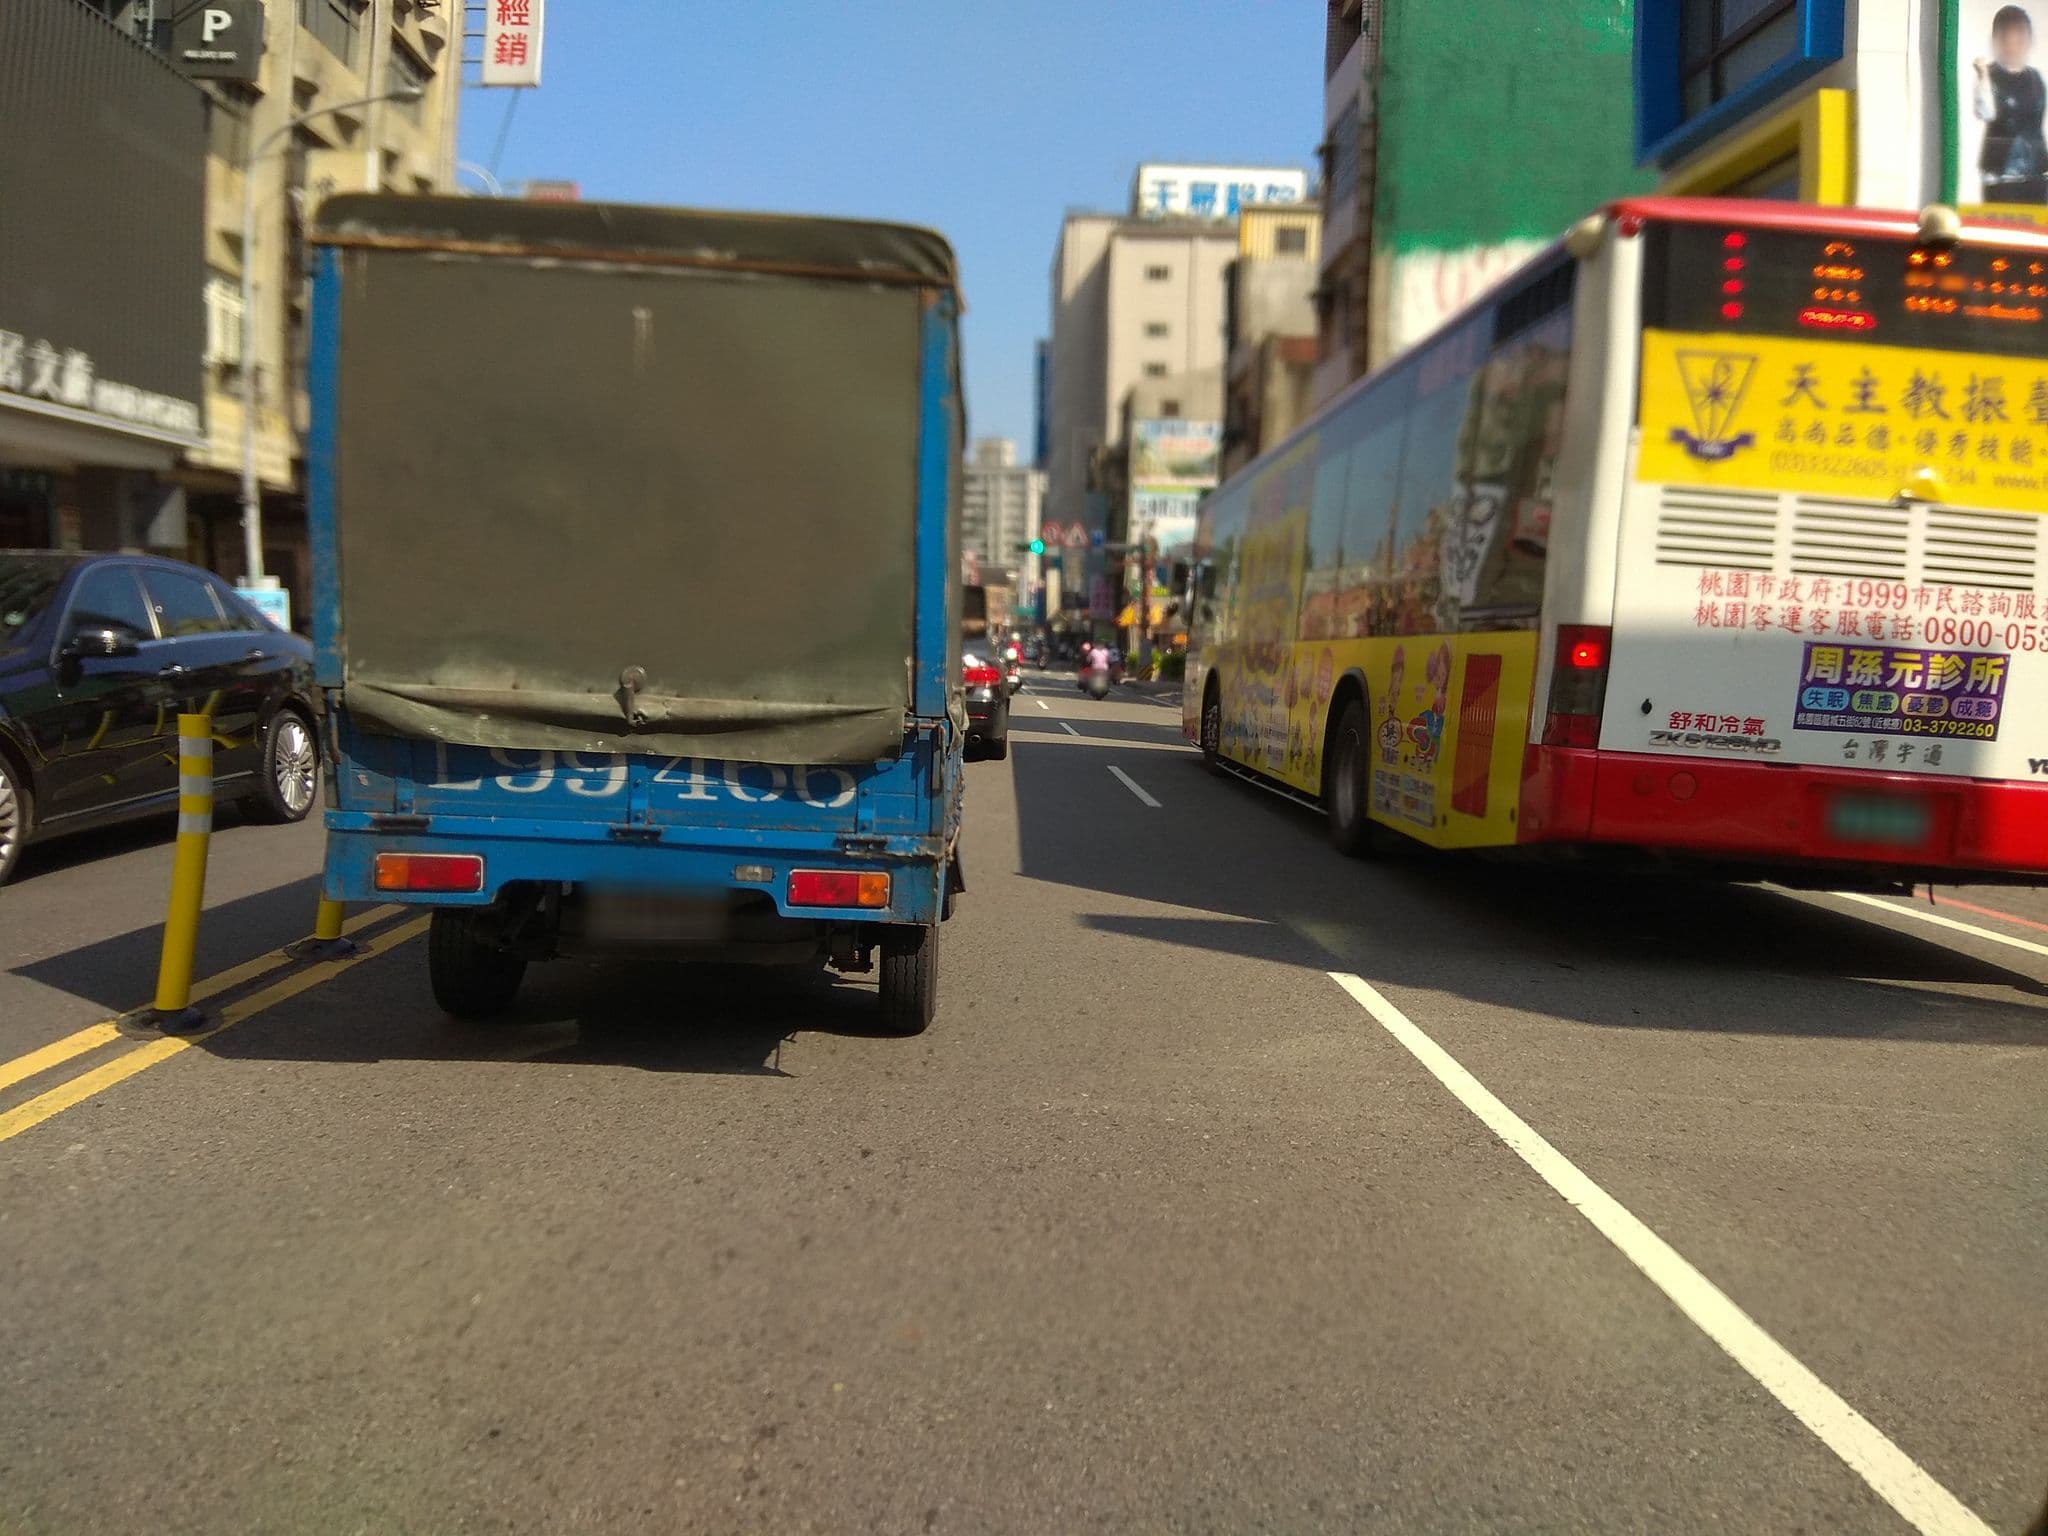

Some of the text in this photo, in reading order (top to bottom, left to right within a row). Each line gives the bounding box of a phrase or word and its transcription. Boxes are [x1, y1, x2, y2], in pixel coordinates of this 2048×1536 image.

[202, 9, 232, 42] P
[1805, 645, 2005, 695] 周孫元診所
[1807, 688, 1845, 709] 失眠
[1857, 691, 1894, 712] 焦慮
[1906, 695, 1944, 715] 憂鬱
[1669, 711, 1766, 737] 舒和冷氣
[1903, 717, 1995, 738] 03-3792260
